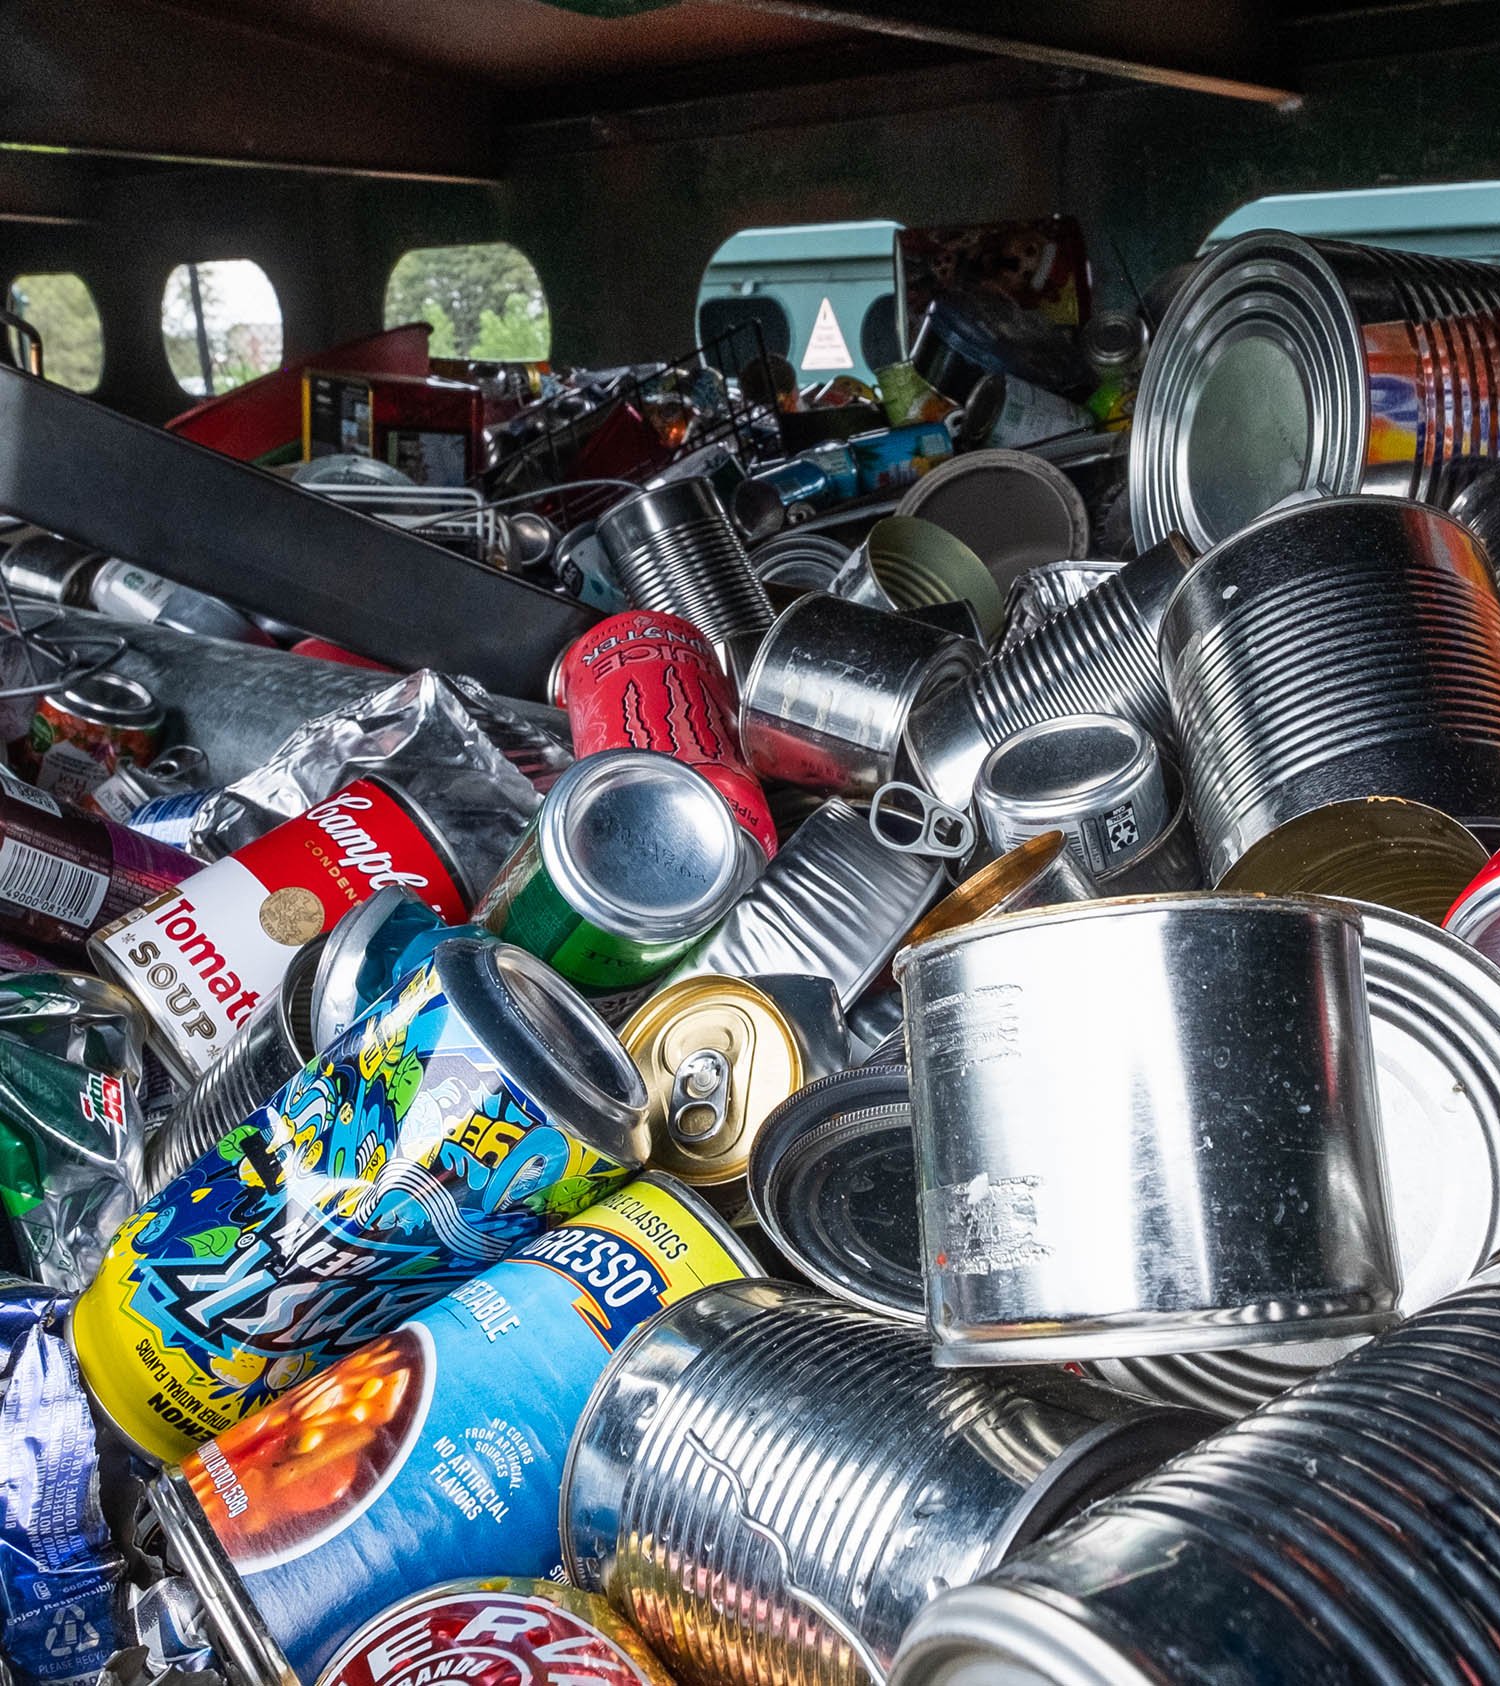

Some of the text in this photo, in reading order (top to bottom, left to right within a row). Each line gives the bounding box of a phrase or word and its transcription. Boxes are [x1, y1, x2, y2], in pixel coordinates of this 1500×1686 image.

[722, 796, 761, 828] PIPE
[303, 838, 364, 908] CONDENS
[5, 887, 39, 907] 49000
[40, 899, 74, 921] 08151
[127, 939, 219, 1042] SOUP
[620, 1195, 689, 1261] CLASSICS
[297, 1241, 391, 1277] ICED
[531, 1228, 653, 1308] GRESSO
[449, 1279, 521, 1344] GETABLE
[135, 1338, 235, 1431] OTHER NATURAL FLAVORS
[147, 1391, 220, 1444] EMON
[491, 1417, 535, 1466] NO COLORS
[432, 1435, 510, 1525] NO ARTIFICIAL
[465, 1428, 524, 1490] FROM ARTIFICIAL
[474, 1441, 509, 1479] SOURCES
[42, 1482, 55, 1511] DRINK
[65, 1487, 78, 1516] DRIVE
[429, 1461, 483, 1522] FLAVORS
[40, 1515, 52, 1535] NOT
[54, 1527, 70, 1554] BIRTH
[6, 1606, 41, 1627] Enjoy
[44, 1581, 117, 1611] Responsibly
[38, 1652, 108, 1675] PLEASE RECYC
